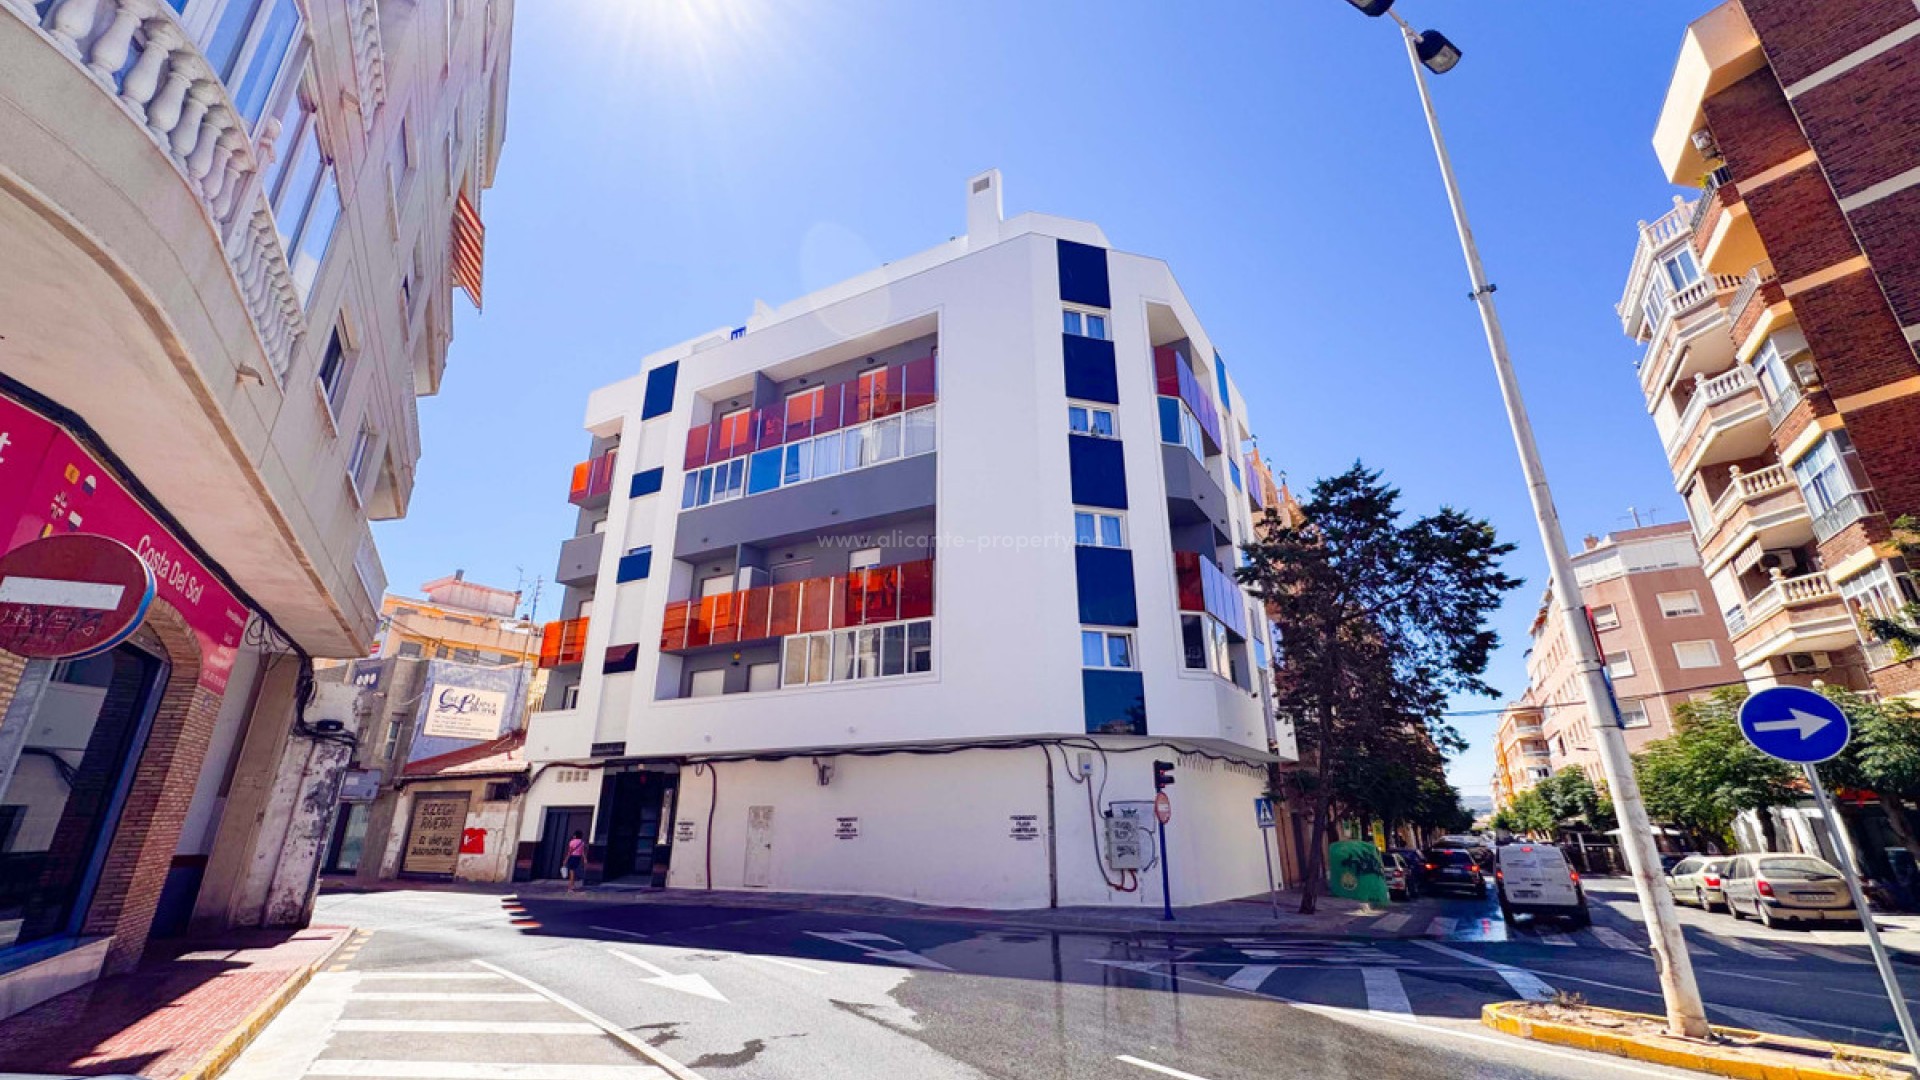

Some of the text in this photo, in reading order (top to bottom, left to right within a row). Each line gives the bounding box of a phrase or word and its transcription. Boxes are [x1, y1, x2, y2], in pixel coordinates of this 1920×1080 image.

[137, 534, 204, 606] Costa Del Sol
